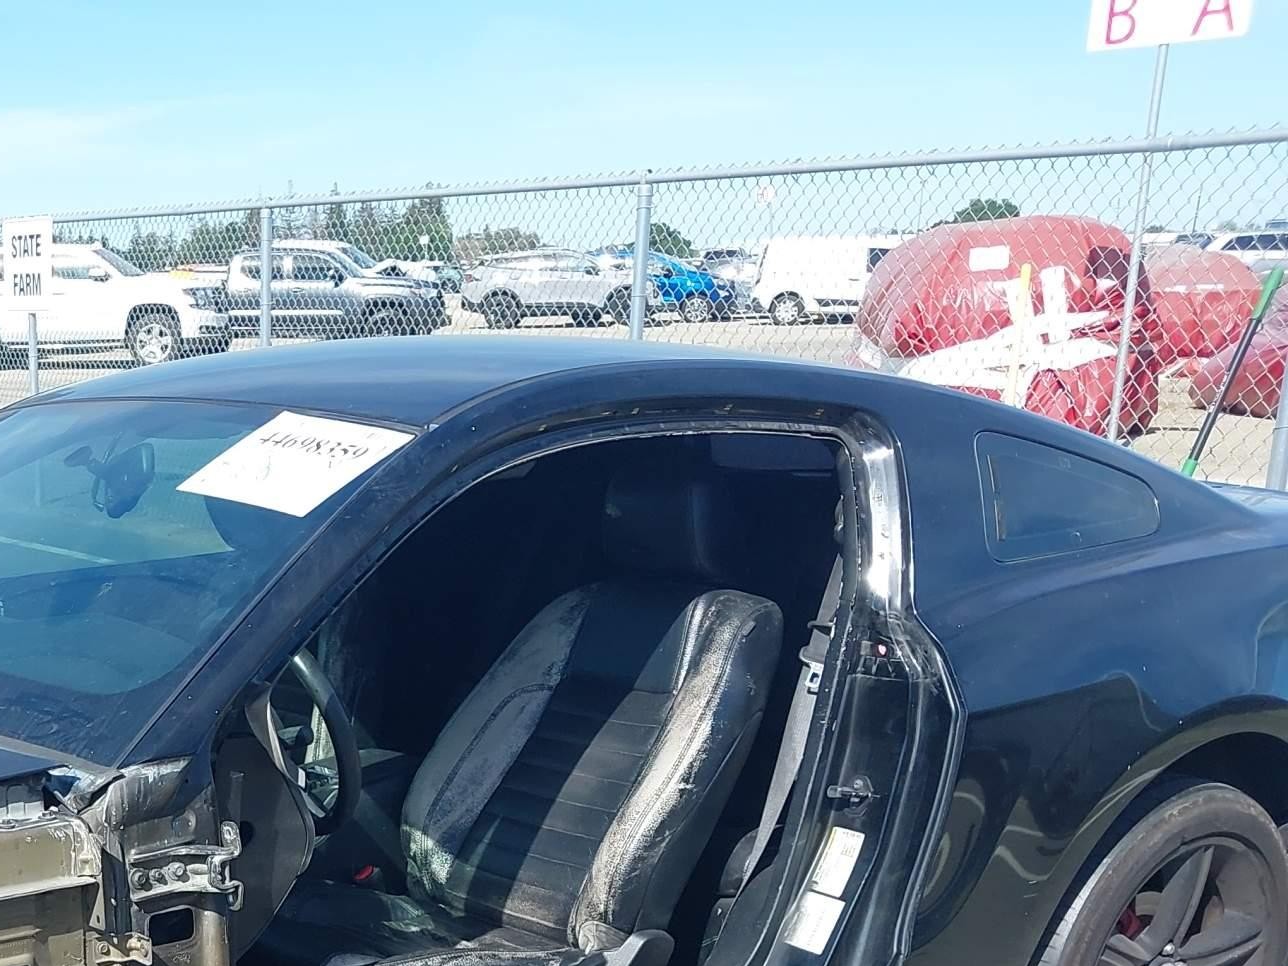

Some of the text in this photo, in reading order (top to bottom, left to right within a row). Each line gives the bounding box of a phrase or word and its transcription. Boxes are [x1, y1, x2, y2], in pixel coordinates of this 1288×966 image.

[1105, 0, 1234, 45] B A
[11, 233, 42, 259] STATE
[13, 272, 42, 297] FARM
